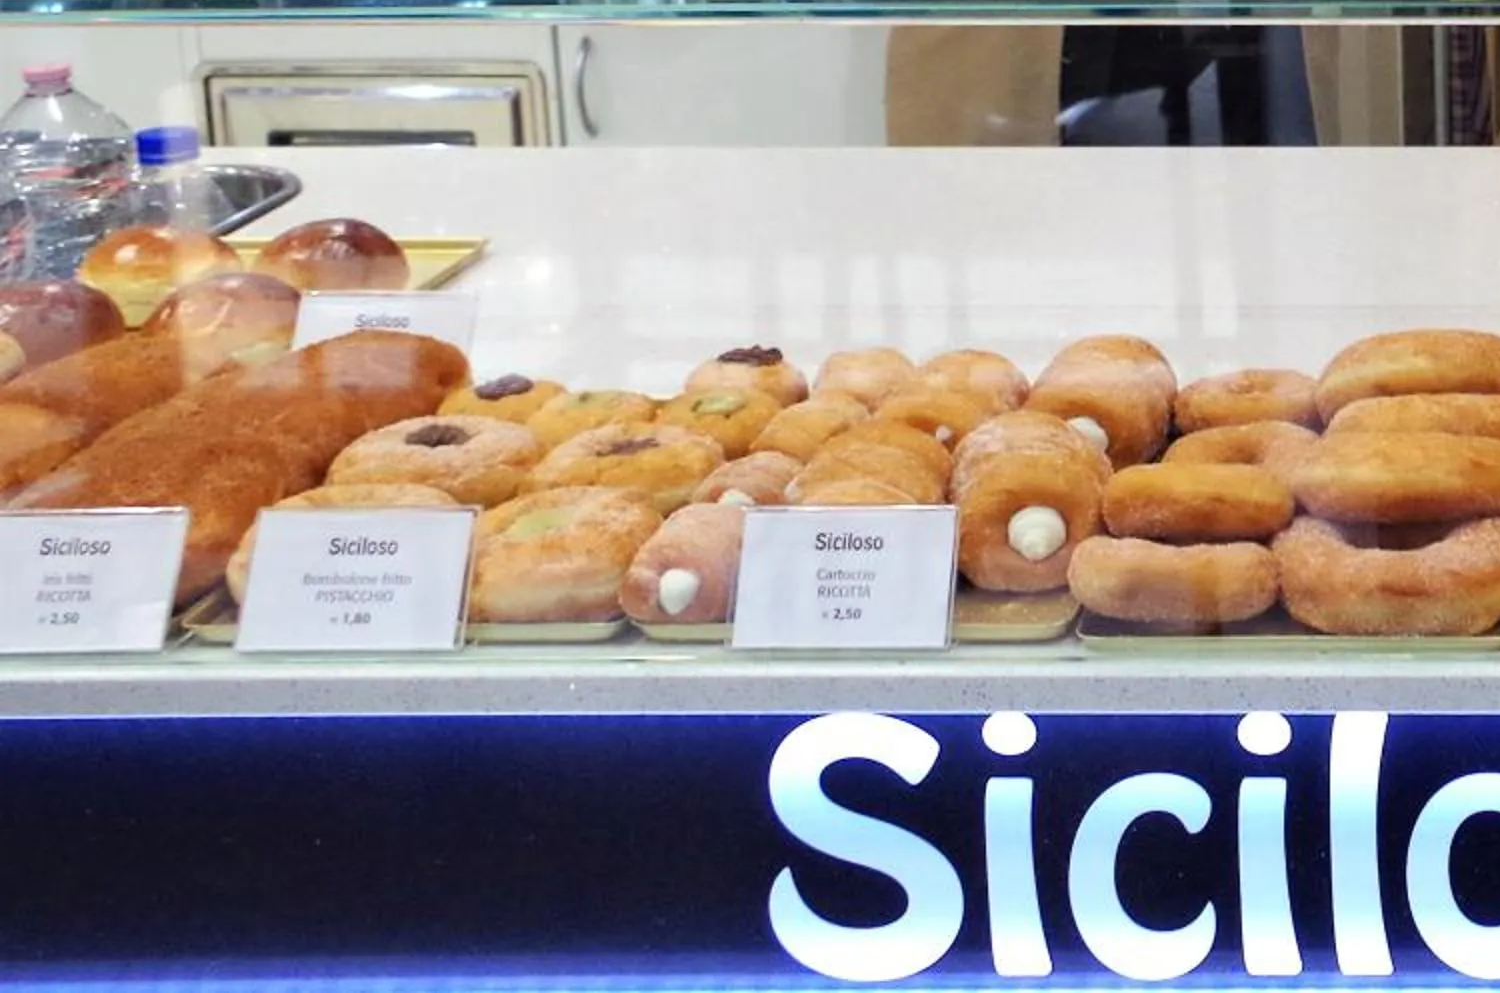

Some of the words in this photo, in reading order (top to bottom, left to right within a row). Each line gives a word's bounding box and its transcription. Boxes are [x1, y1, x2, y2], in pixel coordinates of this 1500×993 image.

[39, 538, 111, 556] Siciloso
[329, 537, 398, 556] Siciloso
[815, 532, 883, 551] Siciloso
[315, 590, 394, 604] PISTACCHIO
[817, 585, 870, 598] RICOTTA
